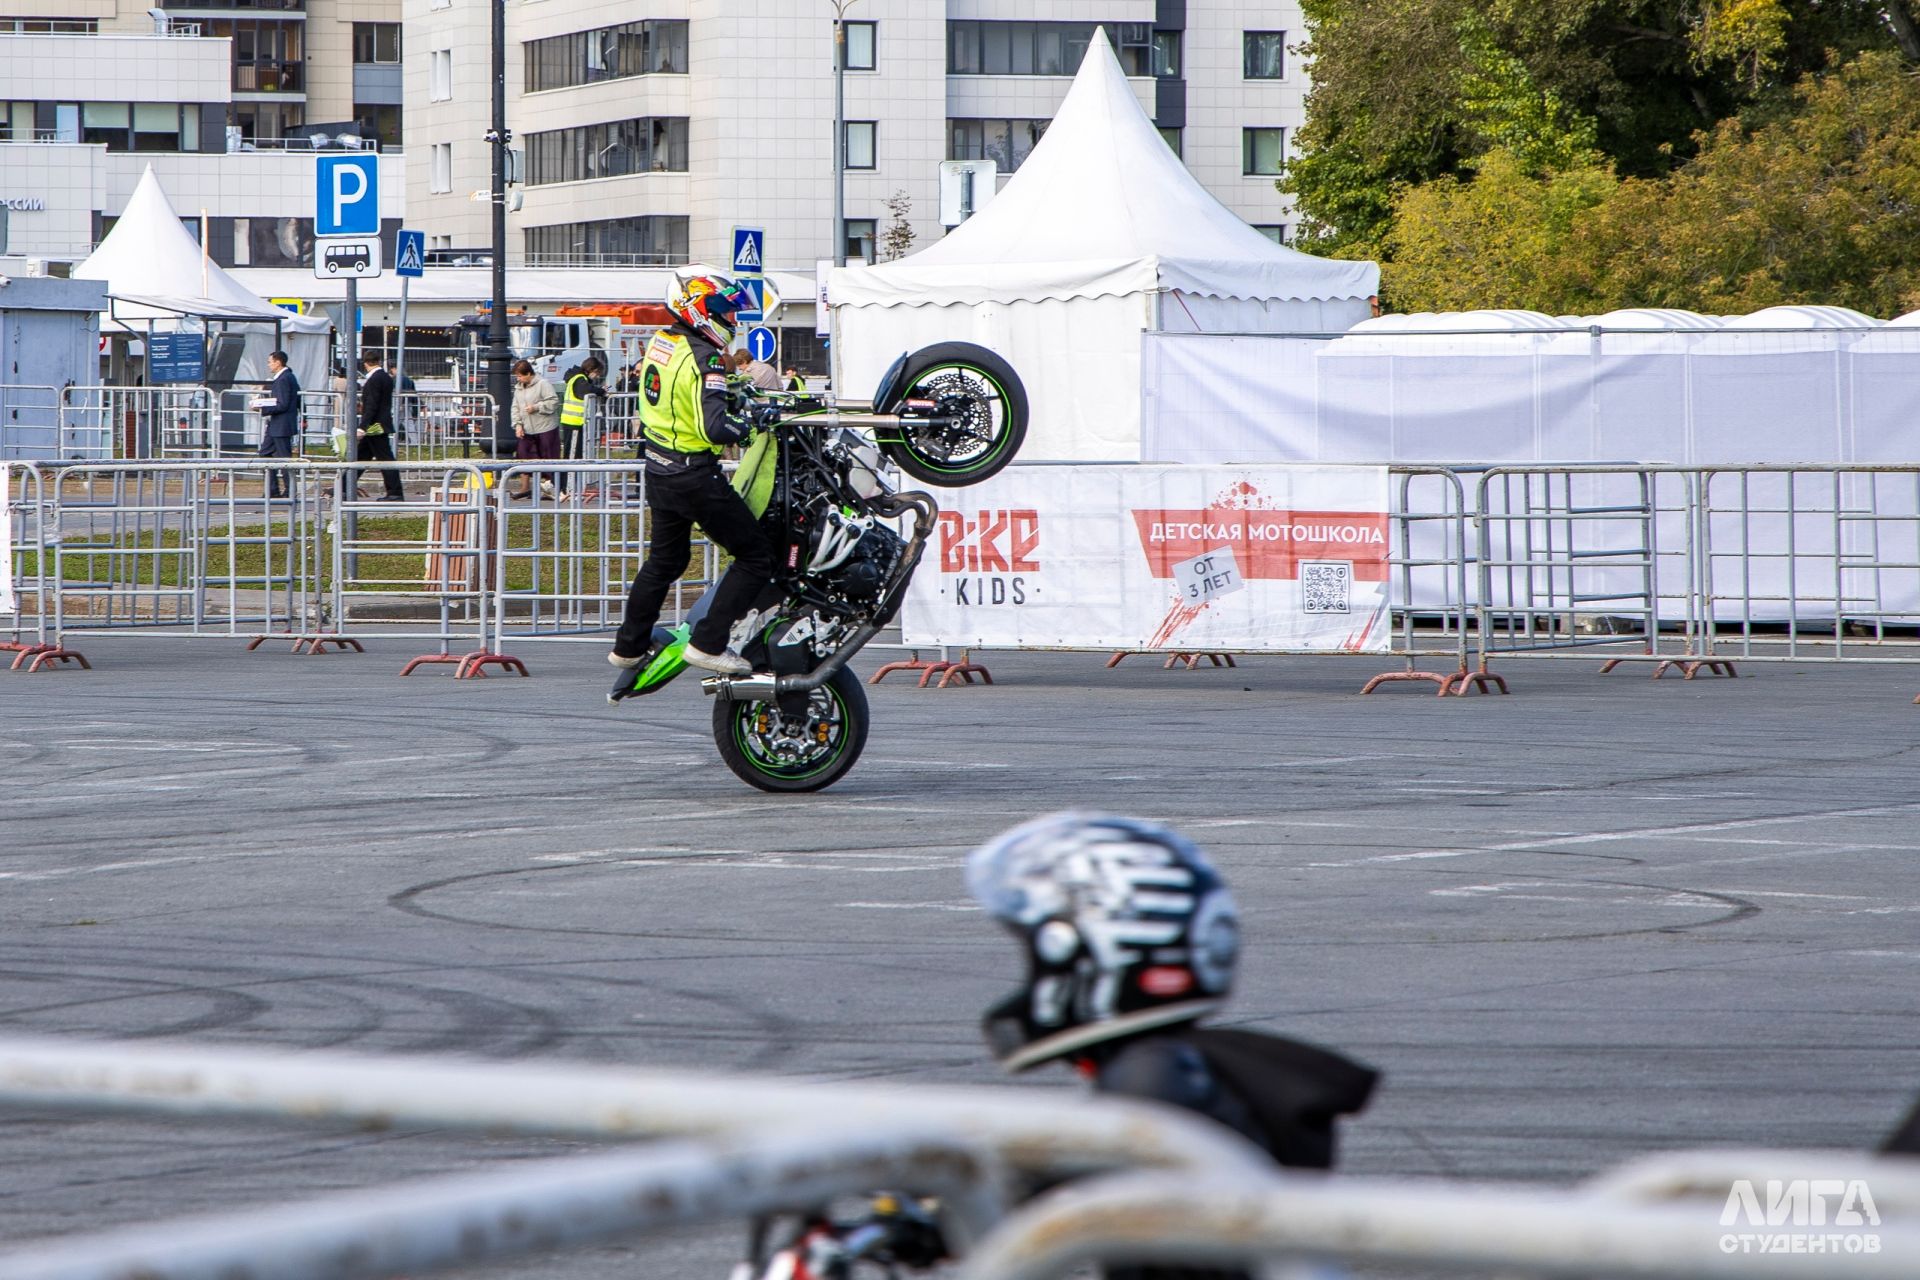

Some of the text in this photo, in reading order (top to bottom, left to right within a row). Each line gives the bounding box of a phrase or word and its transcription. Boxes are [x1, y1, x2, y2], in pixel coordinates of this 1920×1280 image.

[333, 163, 368, 227] P
[1150, 523, 1384, 544] ДЕТСКАЯ МОТОШКОЛА
[1194, 557, 1214, 575] ОТ
[956, 577, 1026, 605] KIDS
[1189, 570, 1231, 598] 3 ЛЕТ
